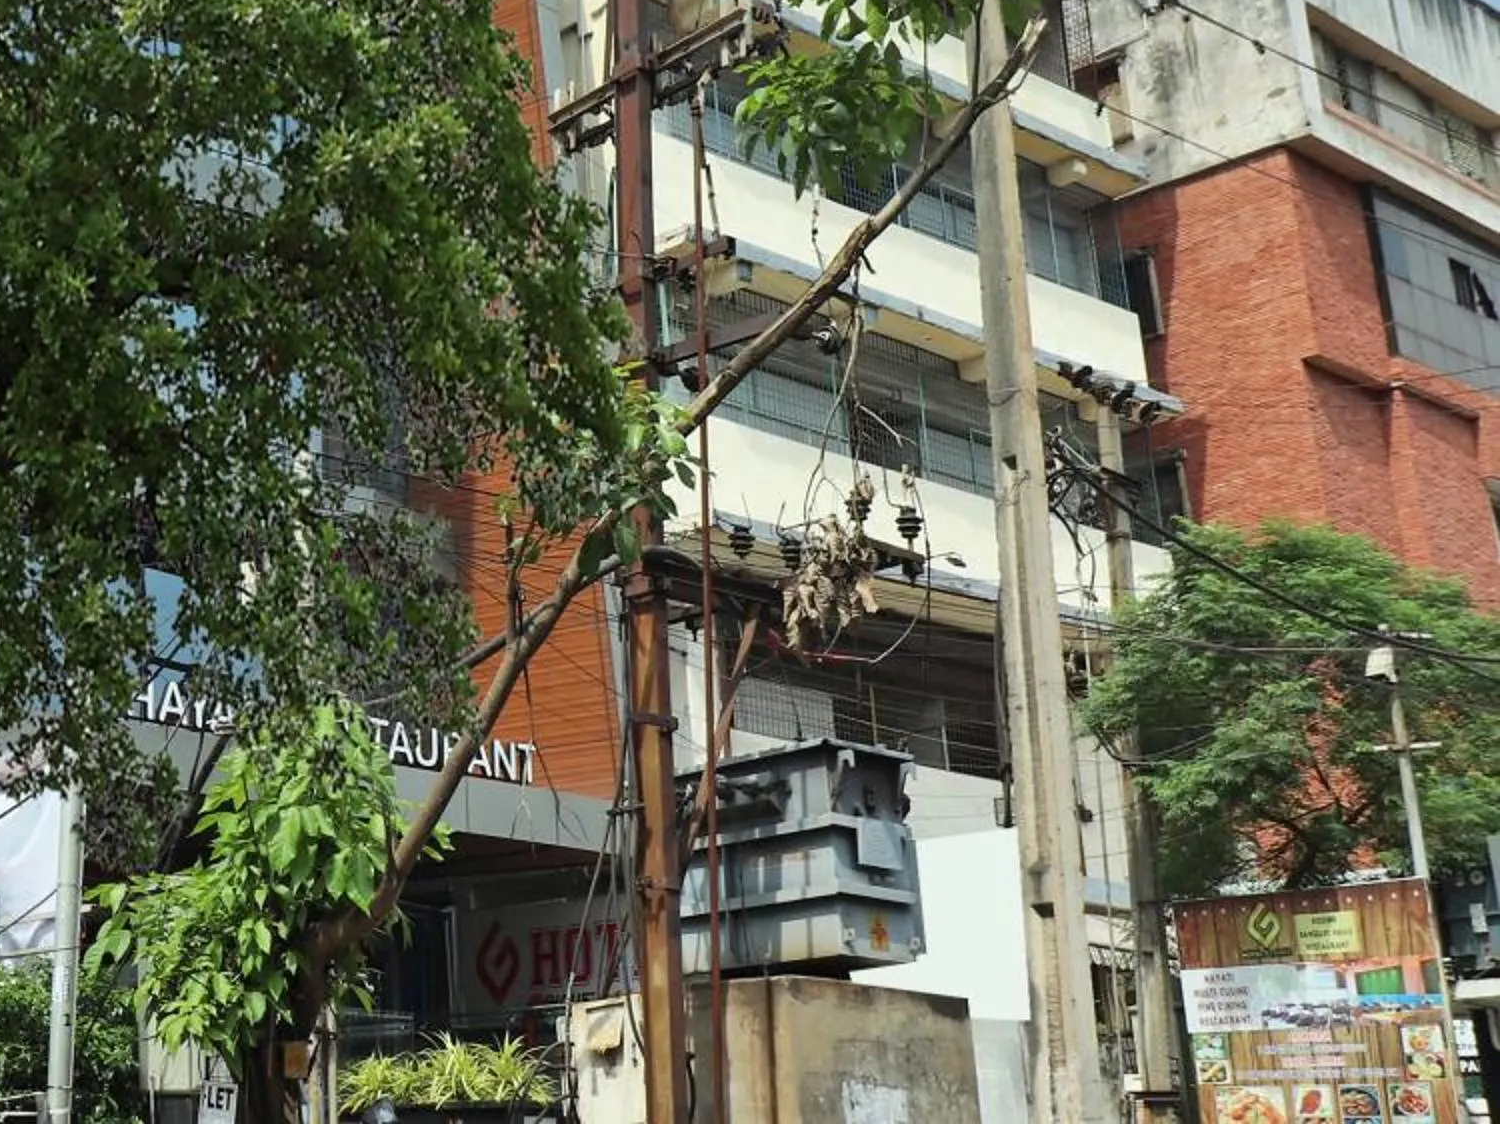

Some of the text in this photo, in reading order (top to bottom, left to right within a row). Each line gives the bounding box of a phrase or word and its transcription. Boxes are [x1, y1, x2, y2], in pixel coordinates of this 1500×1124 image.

[127, 679, 536, 784] HAYA TAUANT
[530, 922, 621, 987] HOT
